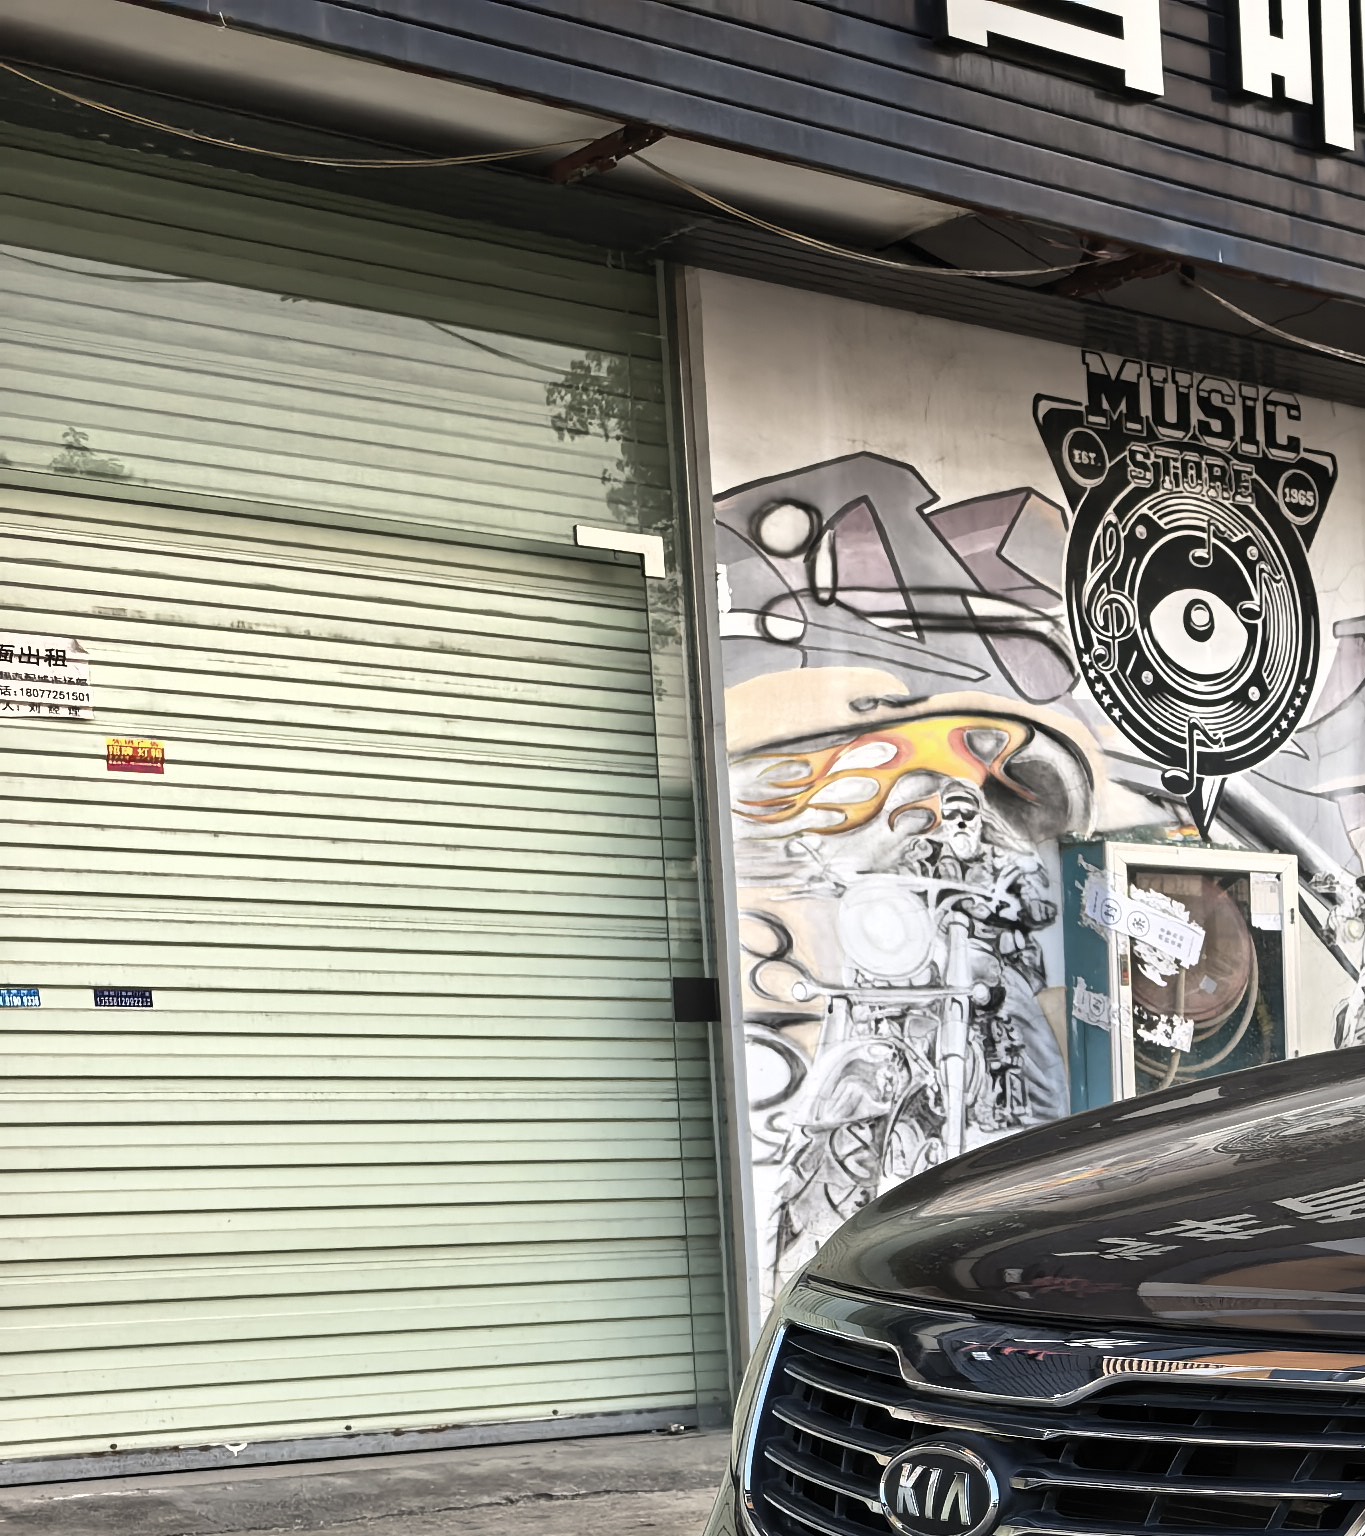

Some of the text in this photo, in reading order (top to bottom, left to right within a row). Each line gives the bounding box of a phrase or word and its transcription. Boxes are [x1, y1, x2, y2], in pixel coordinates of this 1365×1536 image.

[1082, 350, 1302, 461] MUSIC
[1126, 443, 1256, 506] STORE
[897, 1462, 972, 1526] KIA
